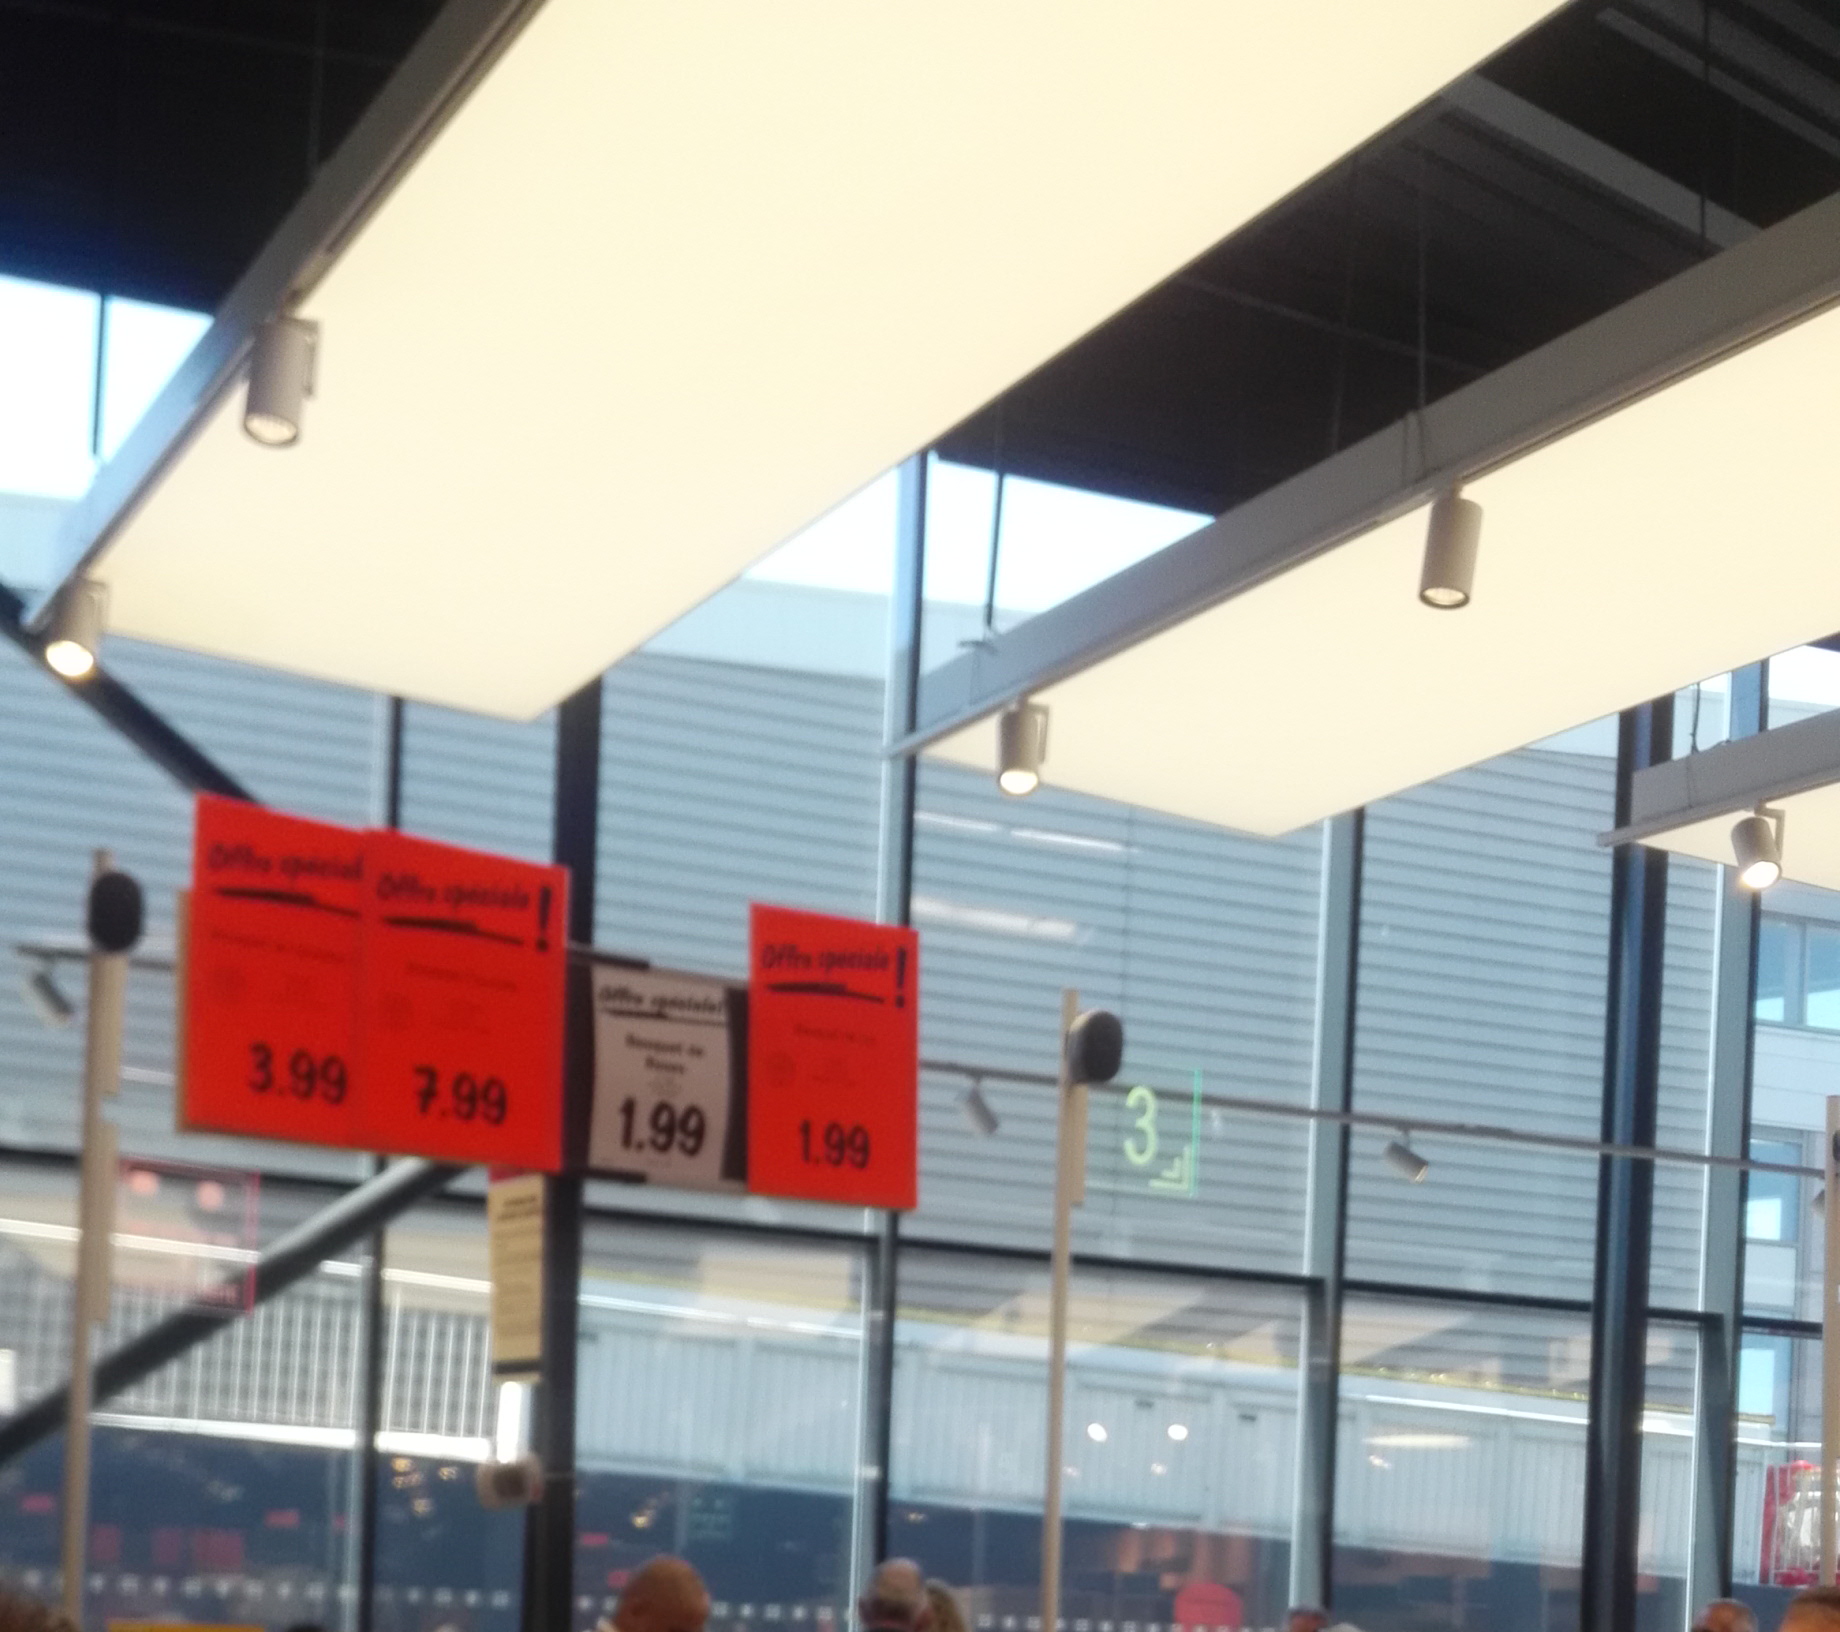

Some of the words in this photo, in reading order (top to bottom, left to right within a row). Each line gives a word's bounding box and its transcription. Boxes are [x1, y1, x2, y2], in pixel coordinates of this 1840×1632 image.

[248, 1041, 348, 1106] 3.99
[413, 1065, 508, 1127] 7.99
[620, 1096, 706, 1158] 1.99
[800, 1119, 870, 1171] 1.99
[1123, 1085, 1157, 1166] 3
